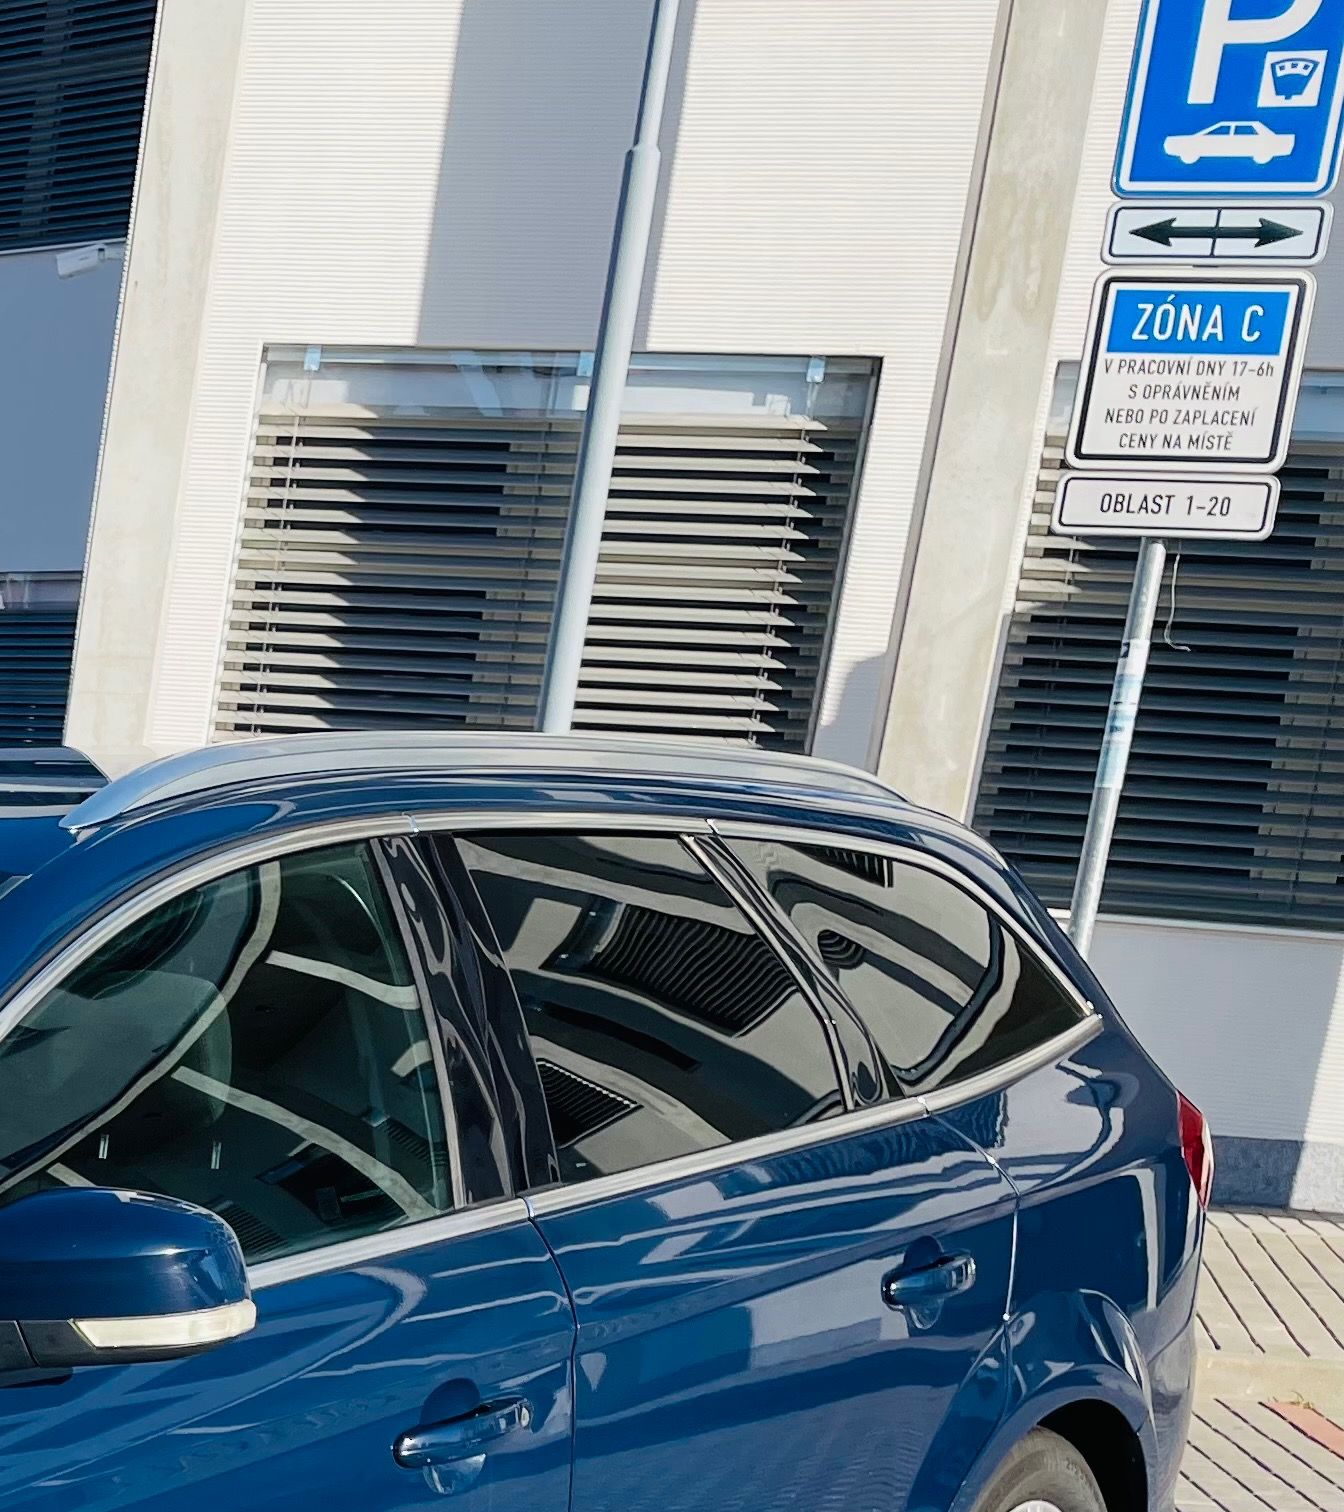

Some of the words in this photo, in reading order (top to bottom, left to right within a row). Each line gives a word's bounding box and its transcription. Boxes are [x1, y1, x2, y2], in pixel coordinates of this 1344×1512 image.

[1187, 0, 1324, 104] P
[1131, 294, 1224, 342] ZÓNA
[1241, 304, 1264, 342] C
[1105, 359, 1114, 375] V
[1117, 356, 1193, 376] PRACOVNÍ
[1196, 360, 1226, 376] DNY
[1232, 360, 1274, 377] 17-6h
[1128, 384, 1138, 400] S
[1143, 381, 1240, 401] OPRÁVNĚNÍM
[1105, 408, 1144, 424] NEBO
[1149, 409, 1168, 425] PO
[1173, 407, 1258, 427] ZAPLACENÍ
[1119, 433, 1158, 449] CENY
[1162, 434, 1182, 449] NA
[1187, 431, 1234, 451] MÍSTĚ
[1100, 493, 1176, 515] OBLAST
[1186, 496, 1232, 517] 1-20
